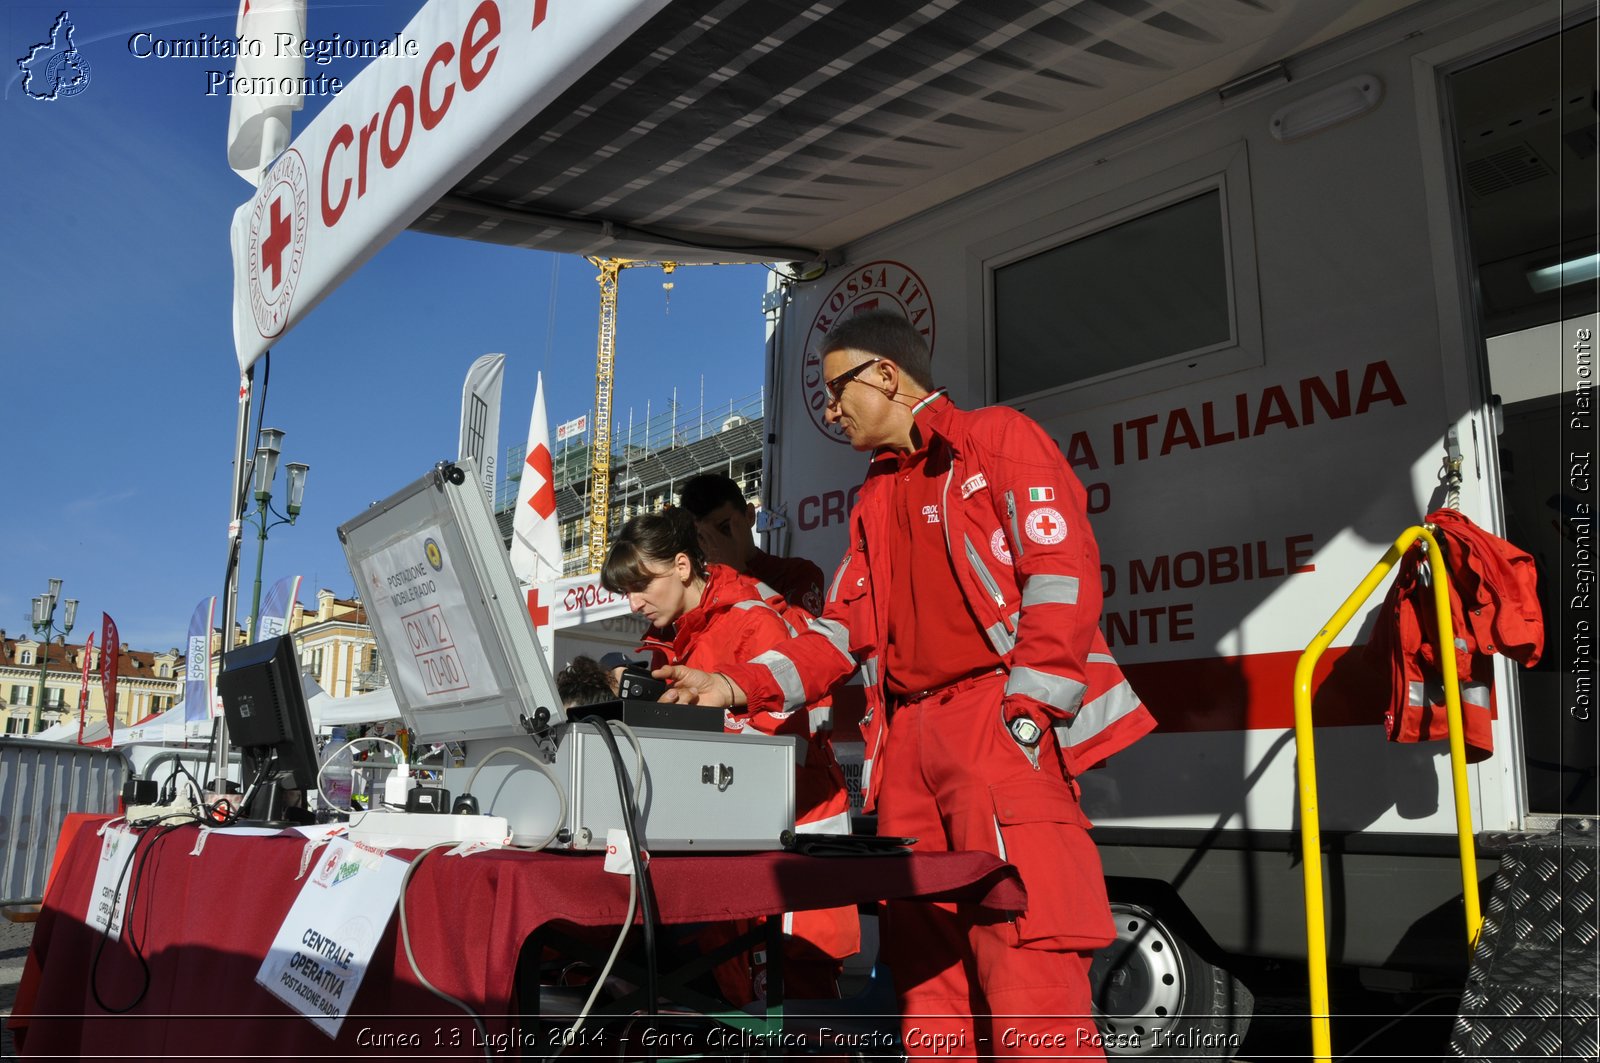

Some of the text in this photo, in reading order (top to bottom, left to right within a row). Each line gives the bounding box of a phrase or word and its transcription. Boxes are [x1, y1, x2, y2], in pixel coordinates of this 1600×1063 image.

[320, 0, 501, 227] Croce
[815, 267, 888, 335] ROSSA
[1112, 360, 1407, 466] ITALIANA
[387, 562, 428, 590] POSTAZIONE
[1129, 533, 1316, 595] MOBILE
[414, 580, 437, 599] RADIO
[407, 614, 448, 650] CN 12
[194, 637, 206, 680] SPORT
[423, 654, 460, 688] 70-00
[302, 928, 354, 970] CENTRALE
[280, 972, 340, 1020] POSTAZIONE RADIO
[290, 951, 344, 1000] OPERATIVA
